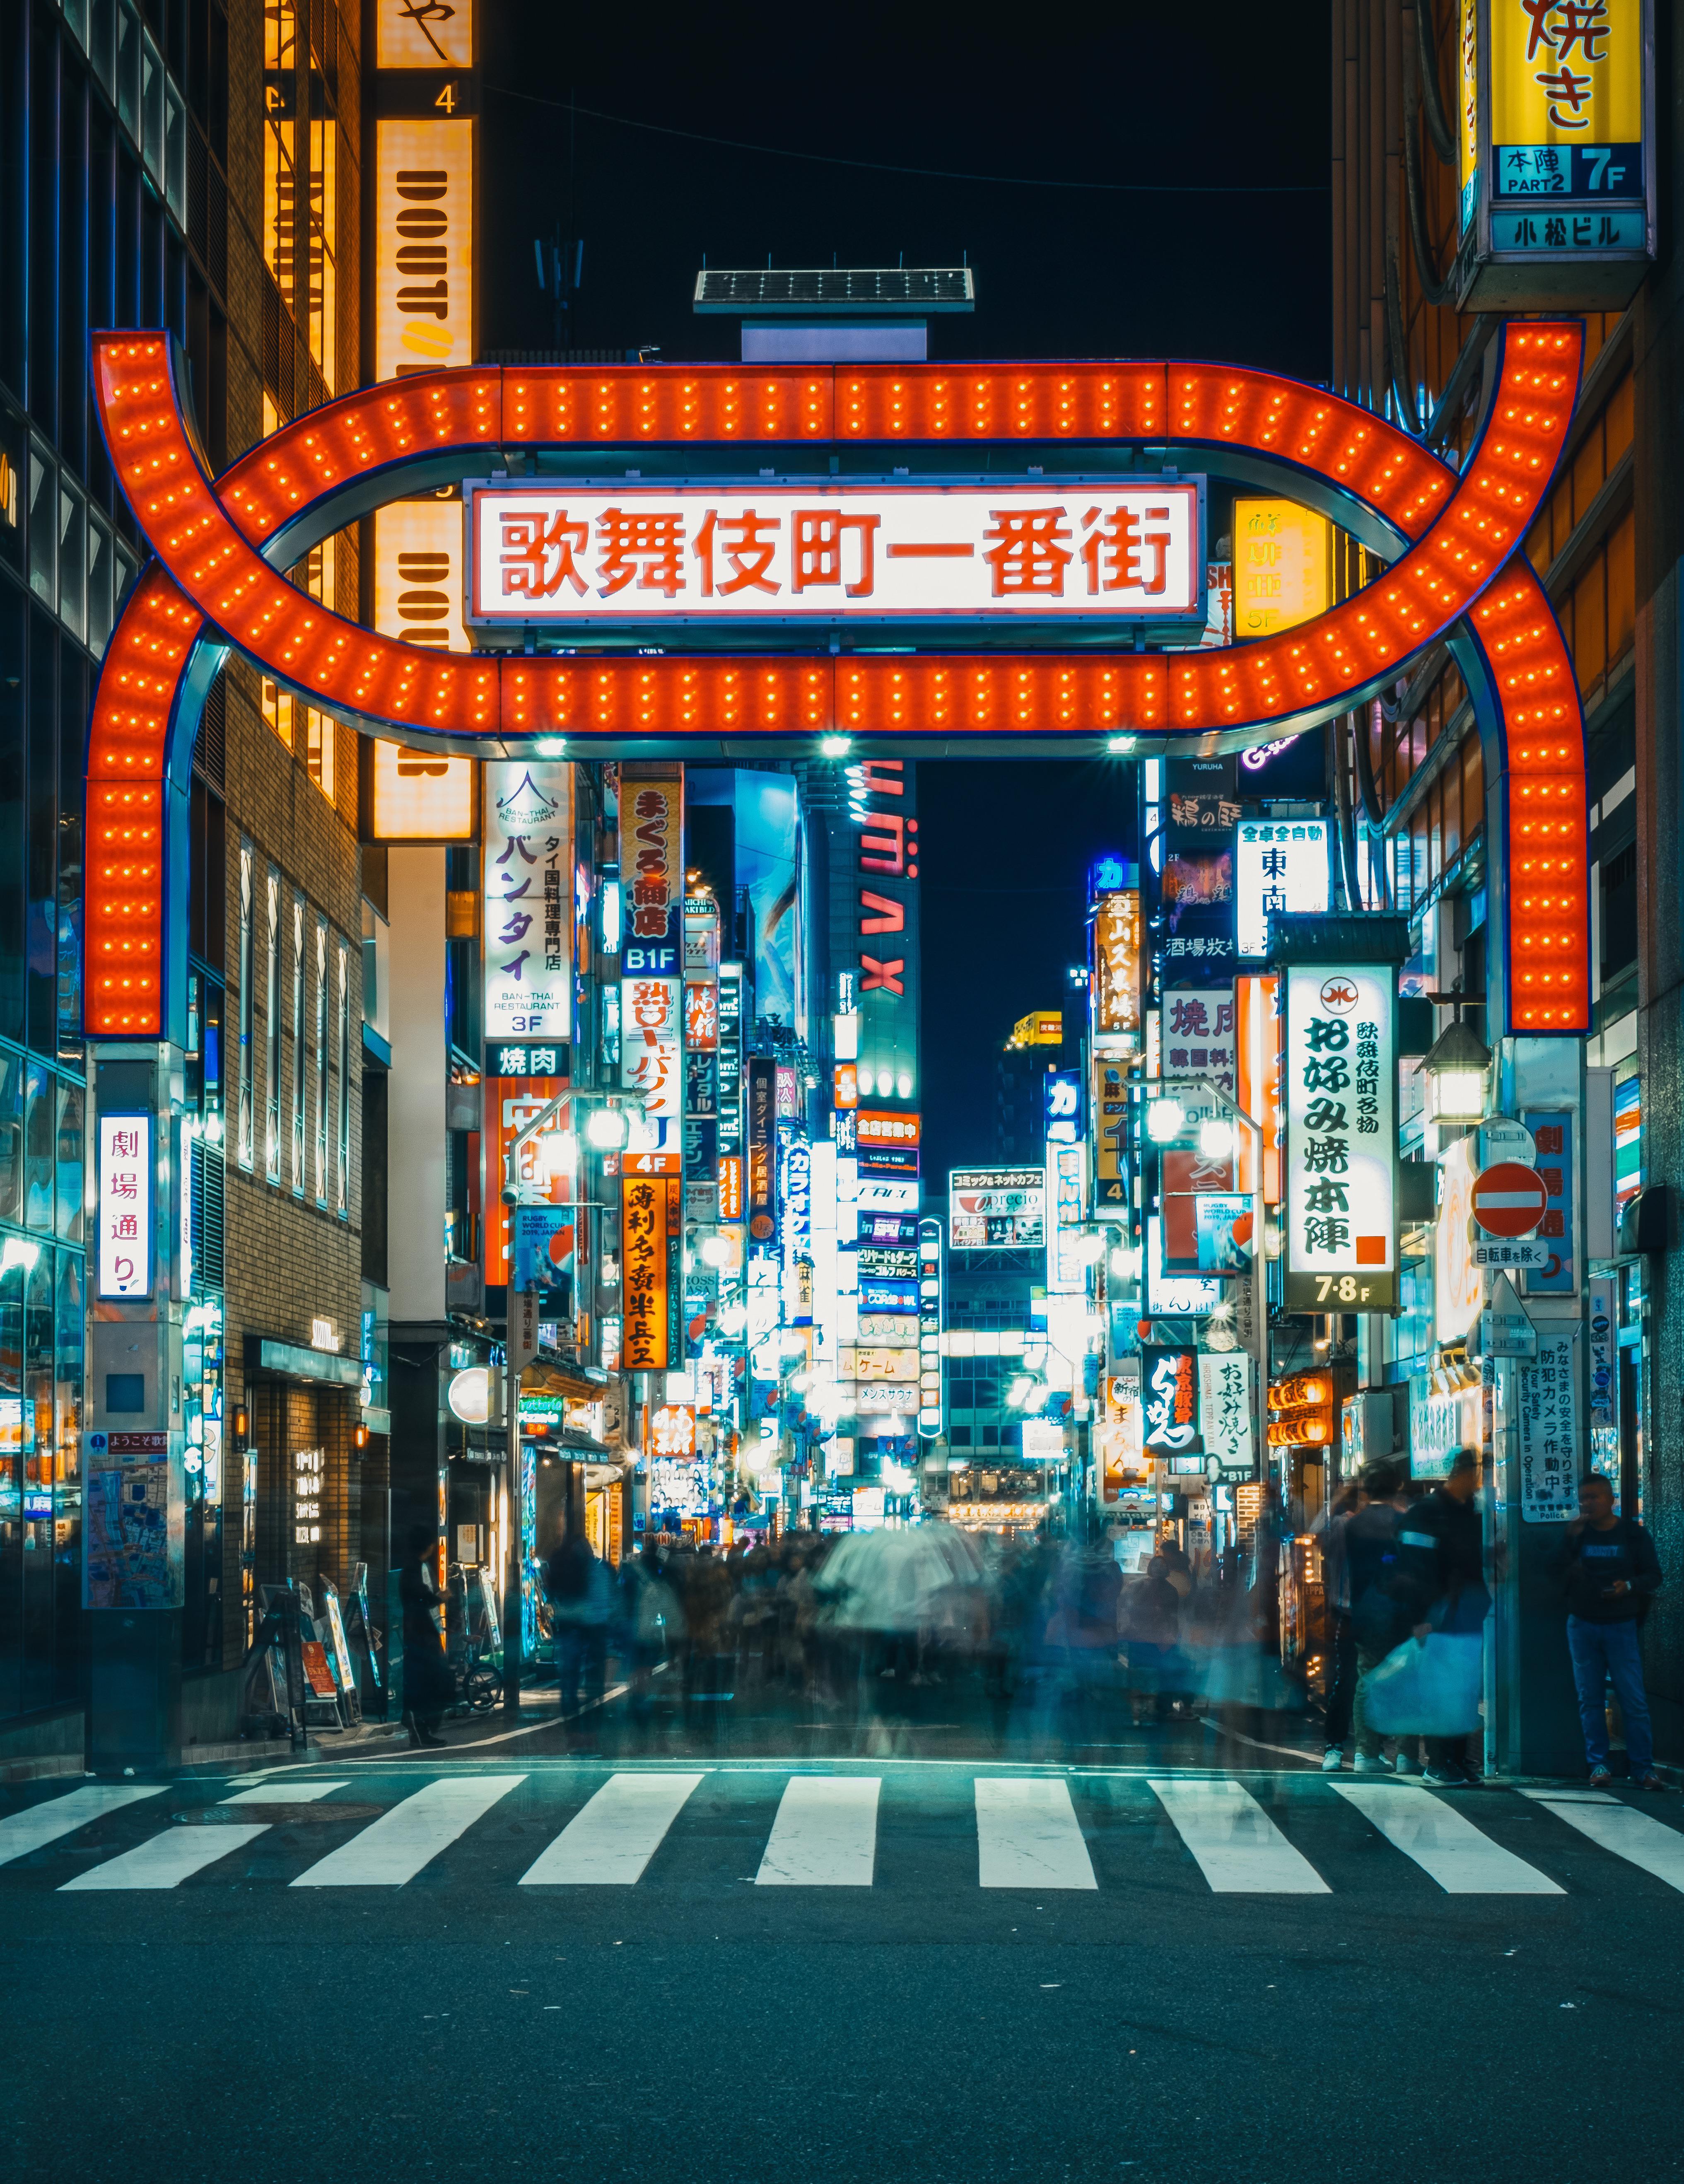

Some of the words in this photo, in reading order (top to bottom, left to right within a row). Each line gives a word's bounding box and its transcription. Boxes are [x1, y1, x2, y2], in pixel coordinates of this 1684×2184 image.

[435, 85, 455, 113] 4
[1507, 147, 1559, 174] 本陣
[1582, 148, 1626, 191] 7F
[1508, 174, 1564, 192] PART2
[1515, 216, 1620, 247] 小松ビル
[500, 507, 1171, 599] 歌舞伎町一番街
[1247, 610, 1277, 628] 5F
[498, 811, 556, 825] RESTAURANT
[506, 807, 549, 818] BAN-THAI
[1242, 825, 1323, 843] 全卓全自動
[634, 790, 669, 938] まぐろ商店
[1168, 854, 1180, 862] 2F
[496, 835, 538, 981] バンタイ
[544, 835, 561, 971] タイ国料理専門店
[627, 948, 676, 970] B1F
[1242, 942, 1256, 954] 3F
[494, 1002, 561, 1011] RESTAURANT
[502, 992, 554, 1001] BAN-THAI
[511, 1016, 543, 1031] 3F
[1113, 1021, 1131, 1030] 5F
[499, 1048, 556, 1075] 焼肉
[1169, 1048, 1234, 1068] 韓国料
[1356, 1021, 1379, 1134] 歌舞伎町名物
[1303, 1017, 1351, 1255] お好み焼本陣
[637, 1154, 666, 1173] 4F
[1107, 1183, 1123, 1199] 4
[111, 1130, 138, 1281] 劇場通り
[1476, 1246, 1542, 1263] 自転車を除く
[1203, 1363, 1212, 1400] HIROSHIMA
[1520, 1366, 1531, 1403] Security
[1530, 1368, 1540, 1389] Your
[1219, 1363, 1248, 1455] お好み焼き
[1530, 1392, 1541, 1421] Safety
[1556, 1341, 1573, 1498] みなさまの安全を守ります
[1205, 1404, 1214, 1447] TEPPANYAKI
[1522, 1406, 1532, 1442] Camera
[1540, 1350, 1561, 1491] 防犯カメラ作動中
[1524, 1444, 1533, 1453] in
[1228, 1471, 1252, 1482] B1F
[1523, 1455, 1535, 1500] Operation
